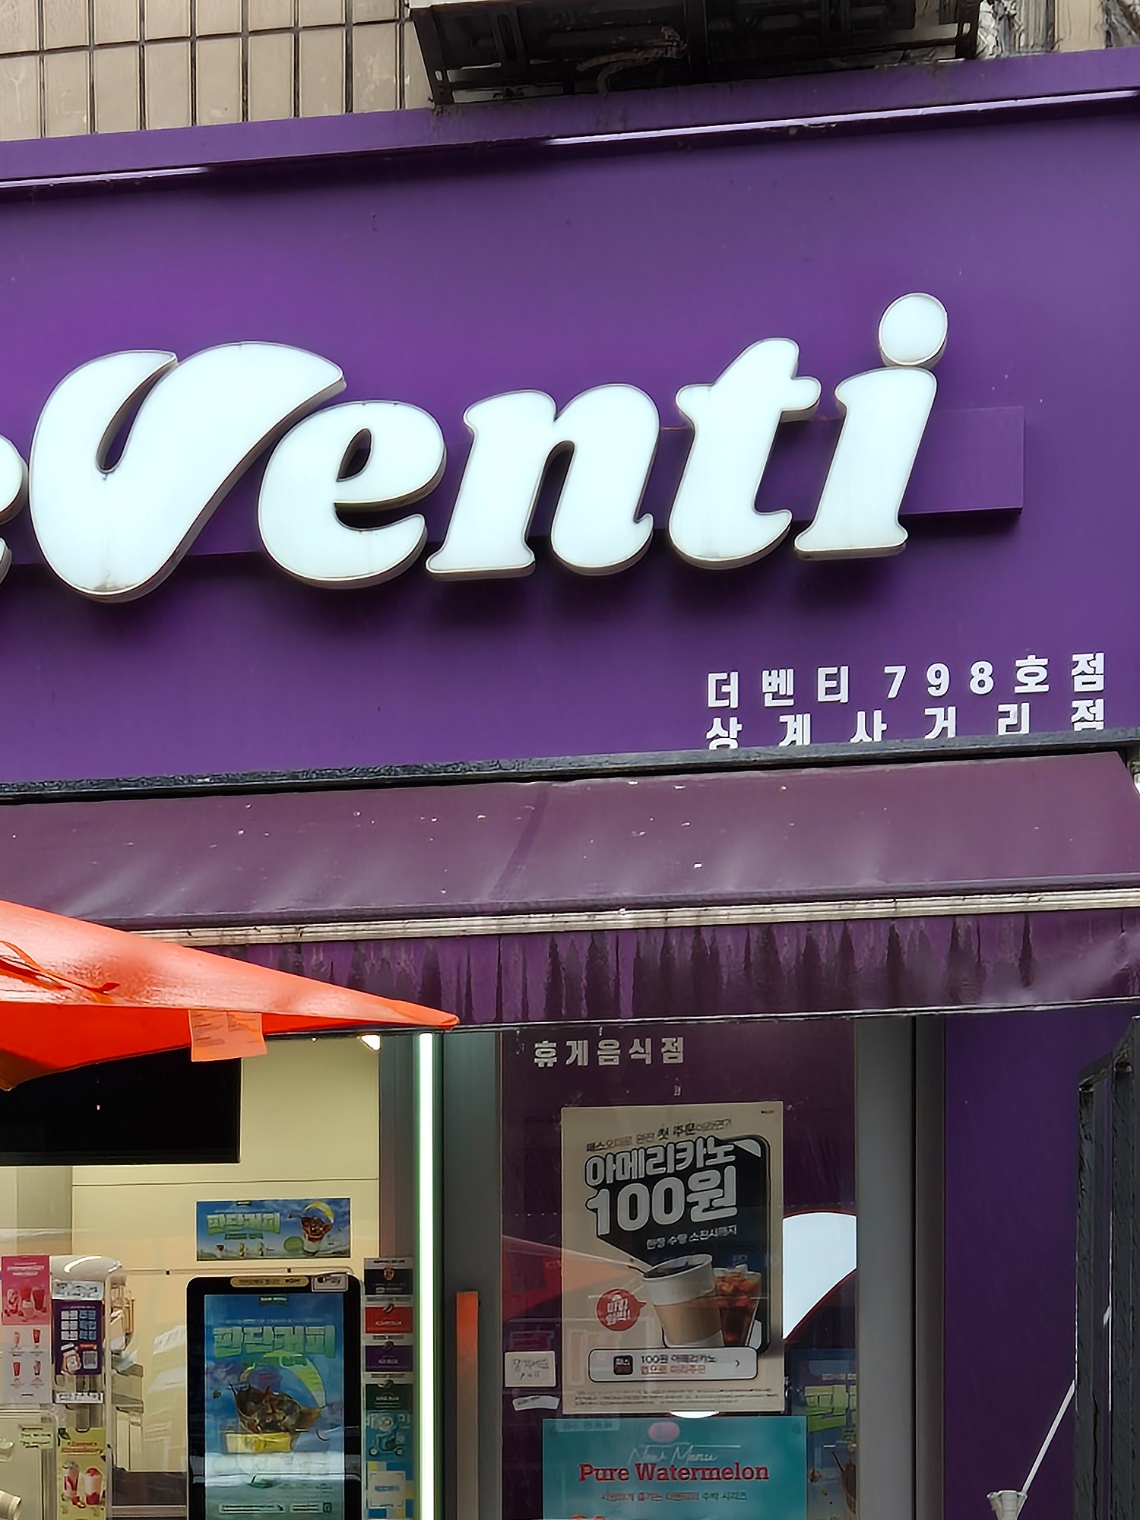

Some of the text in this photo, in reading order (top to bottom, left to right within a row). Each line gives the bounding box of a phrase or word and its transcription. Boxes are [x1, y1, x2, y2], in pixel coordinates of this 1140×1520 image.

[707, 652, 1106, 708] 더벤티 798호점
[533, 1036, 685, 1068] 휴게음식점
[585, 1136, 736, 1187] 아메리카노
[585, 1165, 738, 1235] 100원
[579, 1462, 770, 1482] Pure Watermelon
